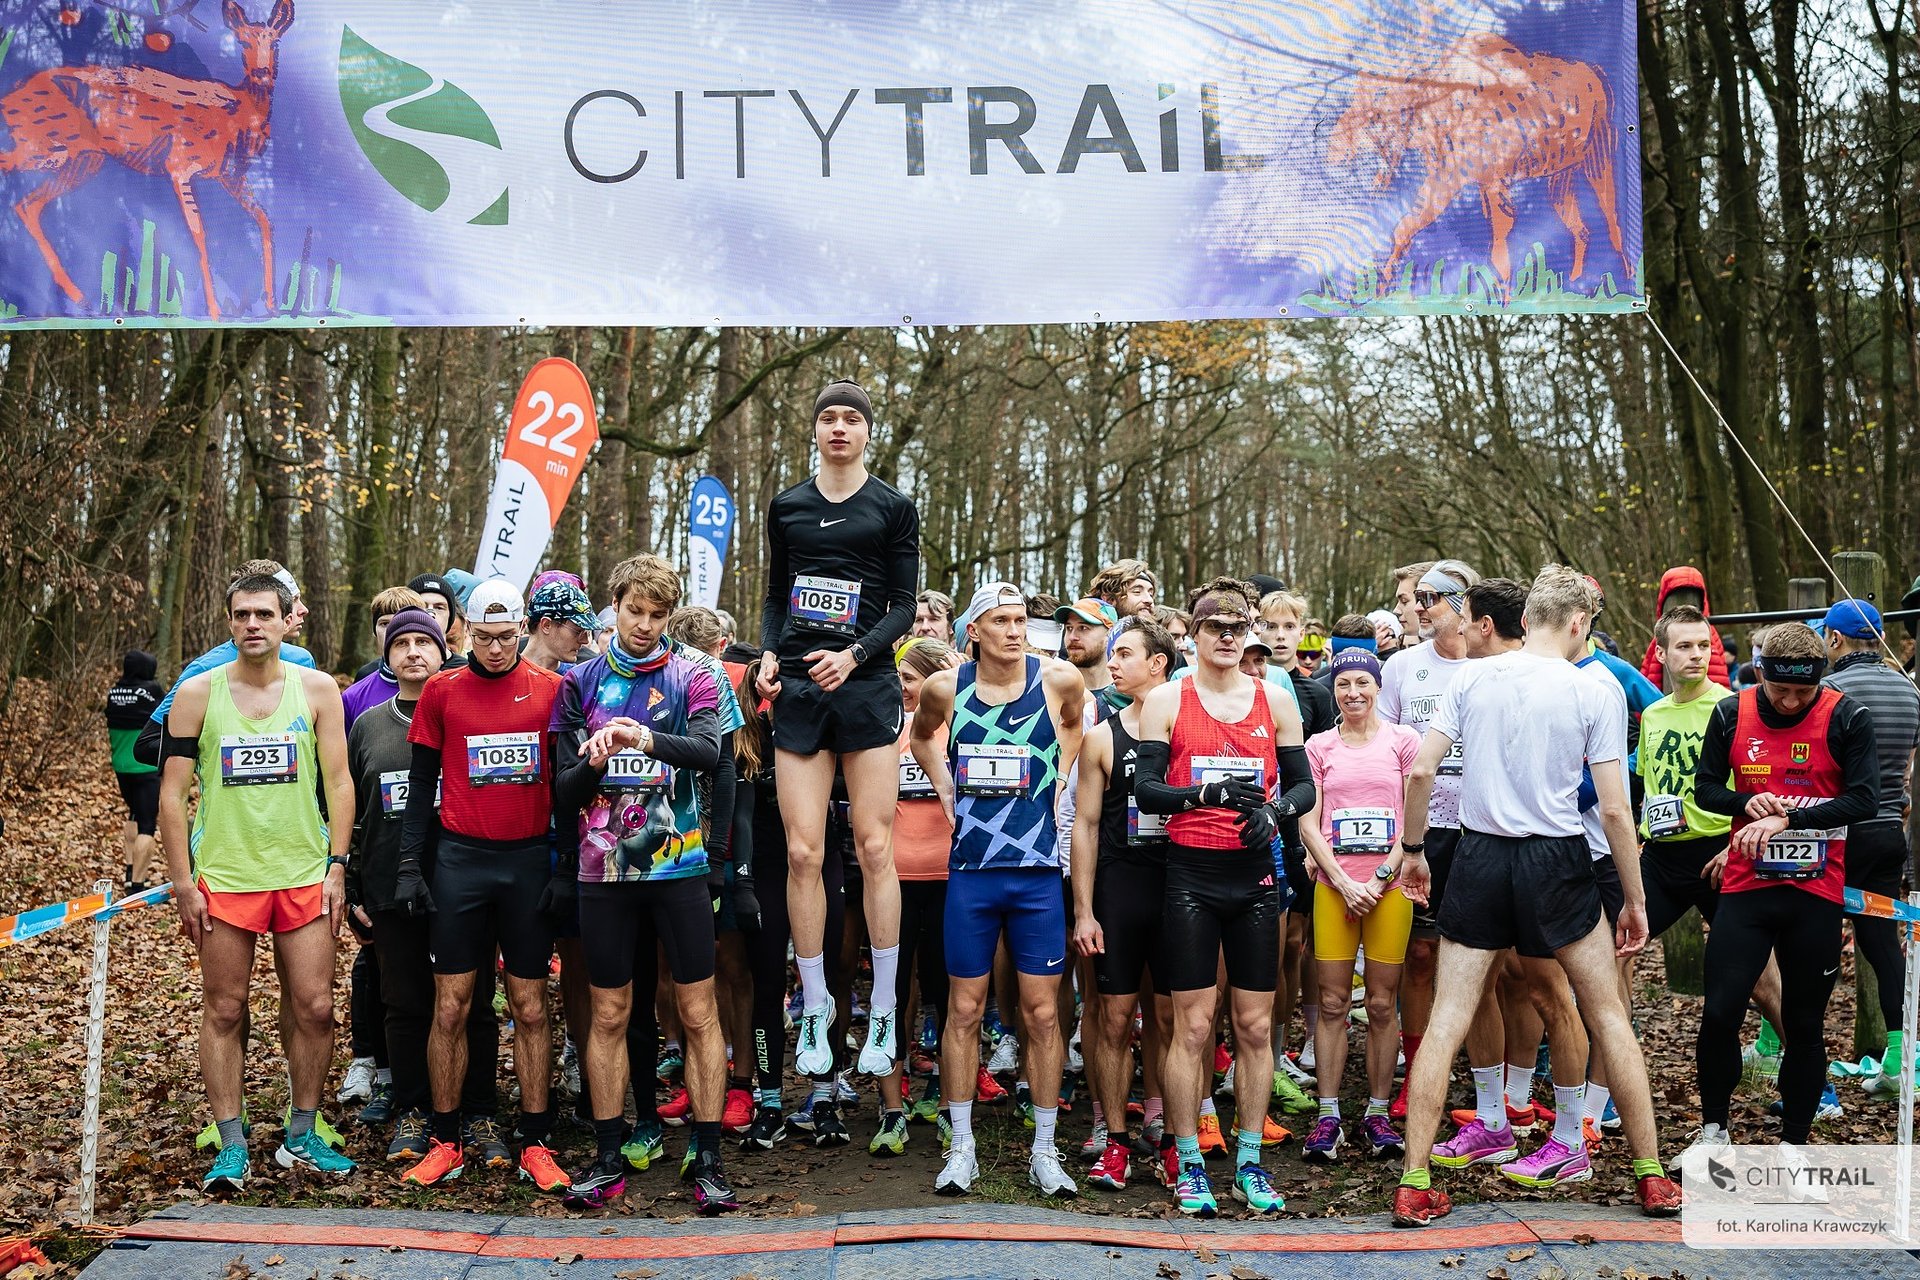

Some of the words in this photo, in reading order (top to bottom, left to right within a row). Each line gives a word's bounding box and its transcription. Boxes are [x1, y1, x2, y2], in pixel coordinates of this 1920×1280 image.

[519, 390, 584, 459] 22
[545, 459, 568, 478] min
[696, 493, 727, 527] 25
[801, 591, 847, 612] 1085
[1333, 655, 1368, 669] KIPRUN
[240, 748, 280, 766] 293
[479, 748, 529, 766] 1083
[612, 758, 657, 774] 1107
[988, 760, 997, 776] 1
[1352, 821, 1373, 836] 12
[1767, 844, 1812, 860] 1122
[755, 1028, 770, 1074] ADIZERO
